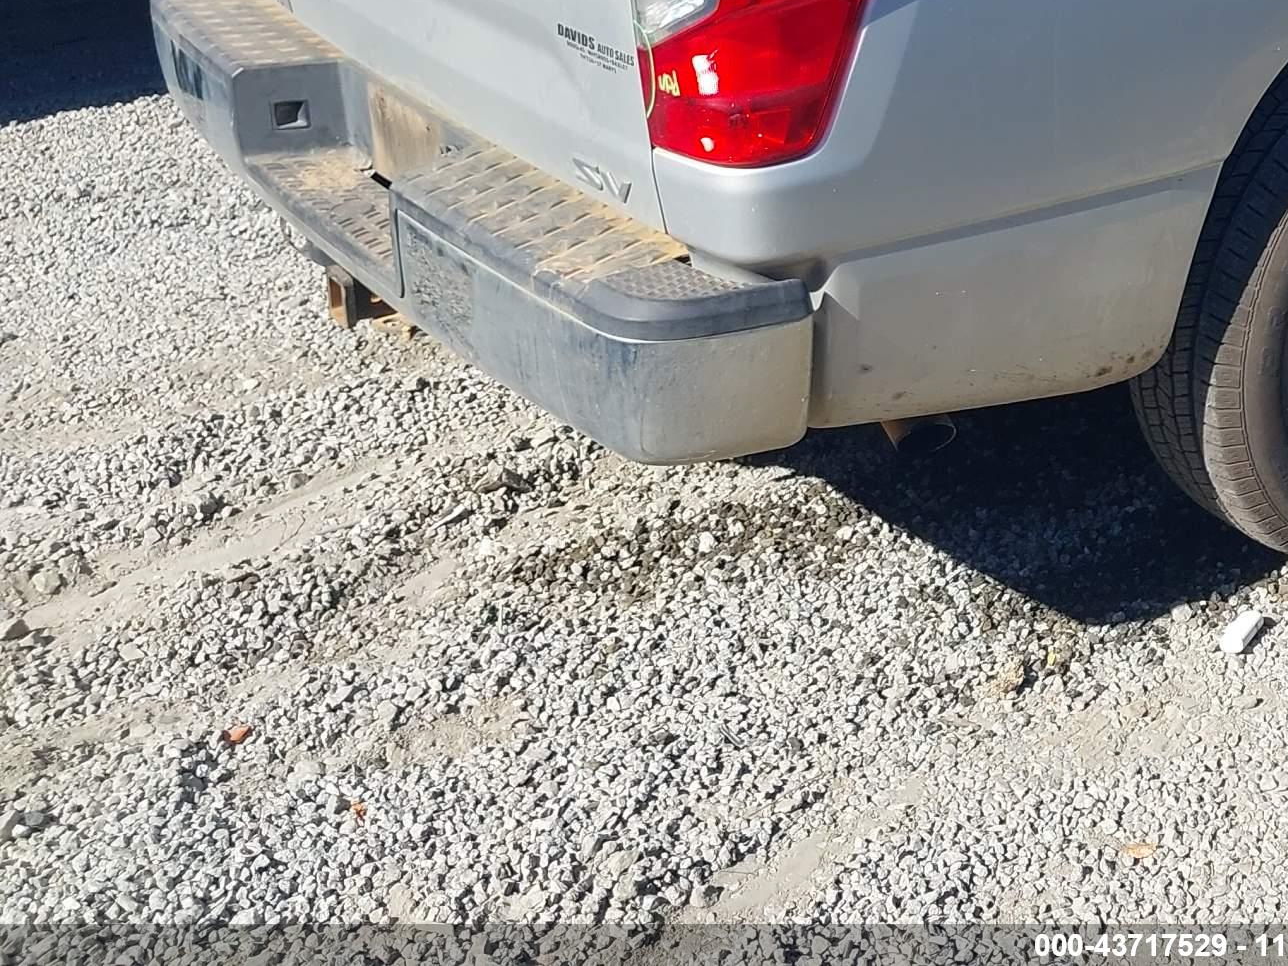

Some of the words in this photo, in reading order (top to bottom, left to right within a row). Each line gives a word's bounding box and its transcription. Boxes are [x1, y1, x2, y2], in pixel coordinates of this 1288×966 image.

[557, 22, 596, 50] DAVIDS
[597, 43, 614, 58] AUTO
[614, 50, 635, 67] SALES
[572, 157, 632, 204] SV
